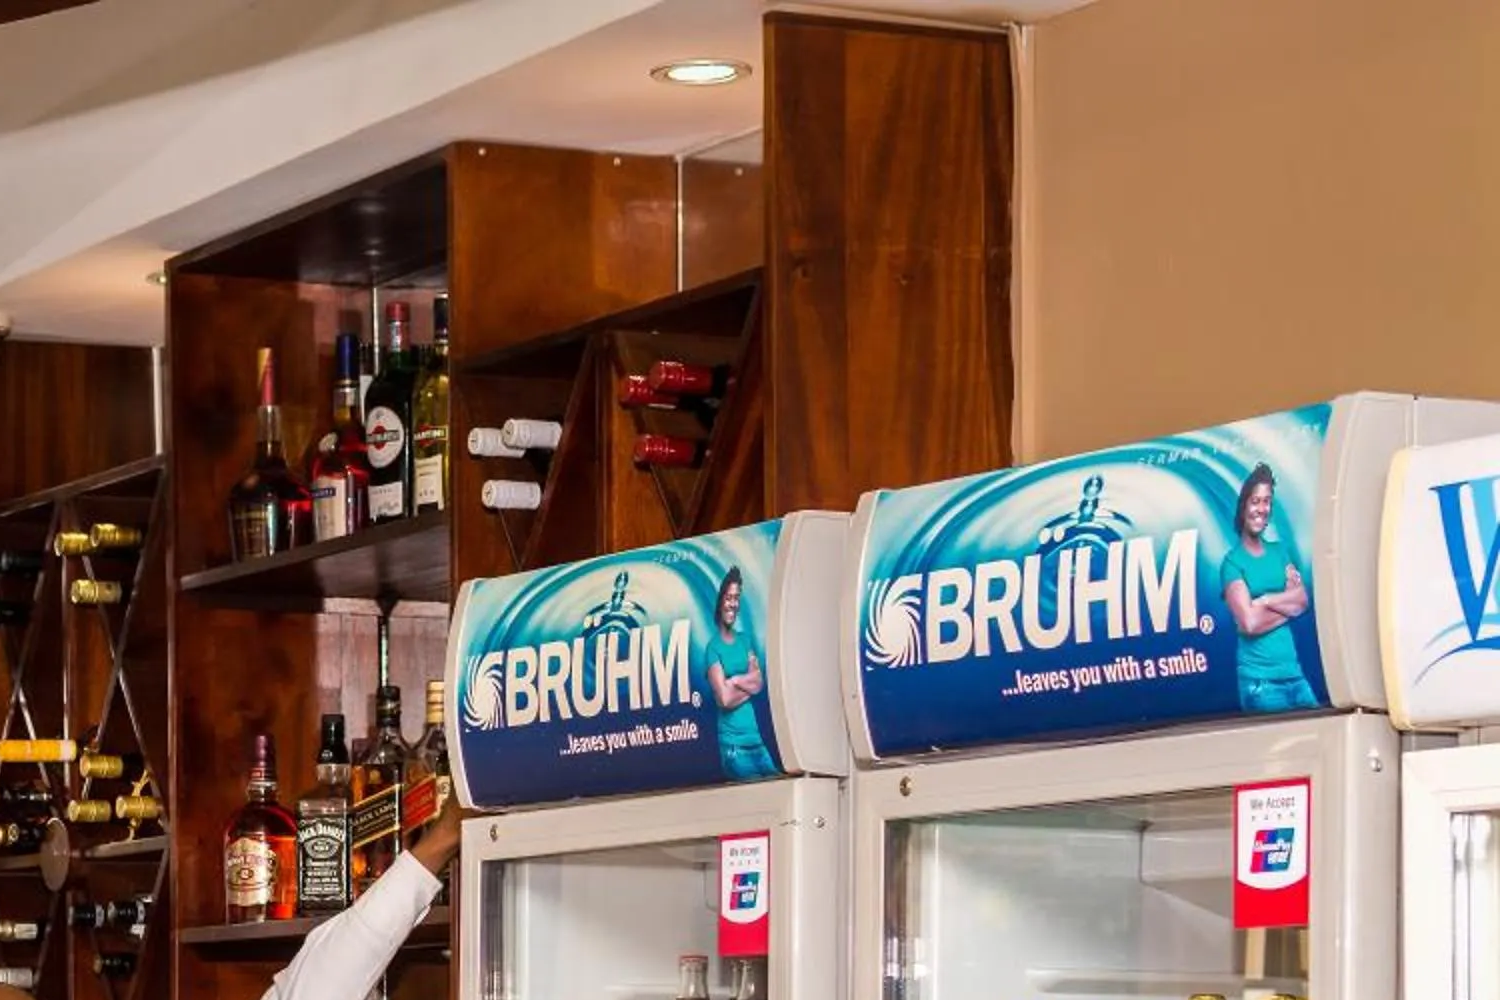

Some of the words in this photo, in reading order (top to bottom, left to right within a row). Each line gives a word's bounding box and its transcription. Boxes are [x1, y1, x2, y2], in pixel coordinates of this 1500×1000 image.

[1071, 665, 1101, 693] you
[1103, 656, 1142, 683] with
[1143, 659, 1157, 679] a
[1158, 648, 1208, 677] smile
[606, 731, 627, 754] you
[628, 724, 654, 746] with
[655, 728, 665, 744] a
[665, 719, 699, 742] smile
